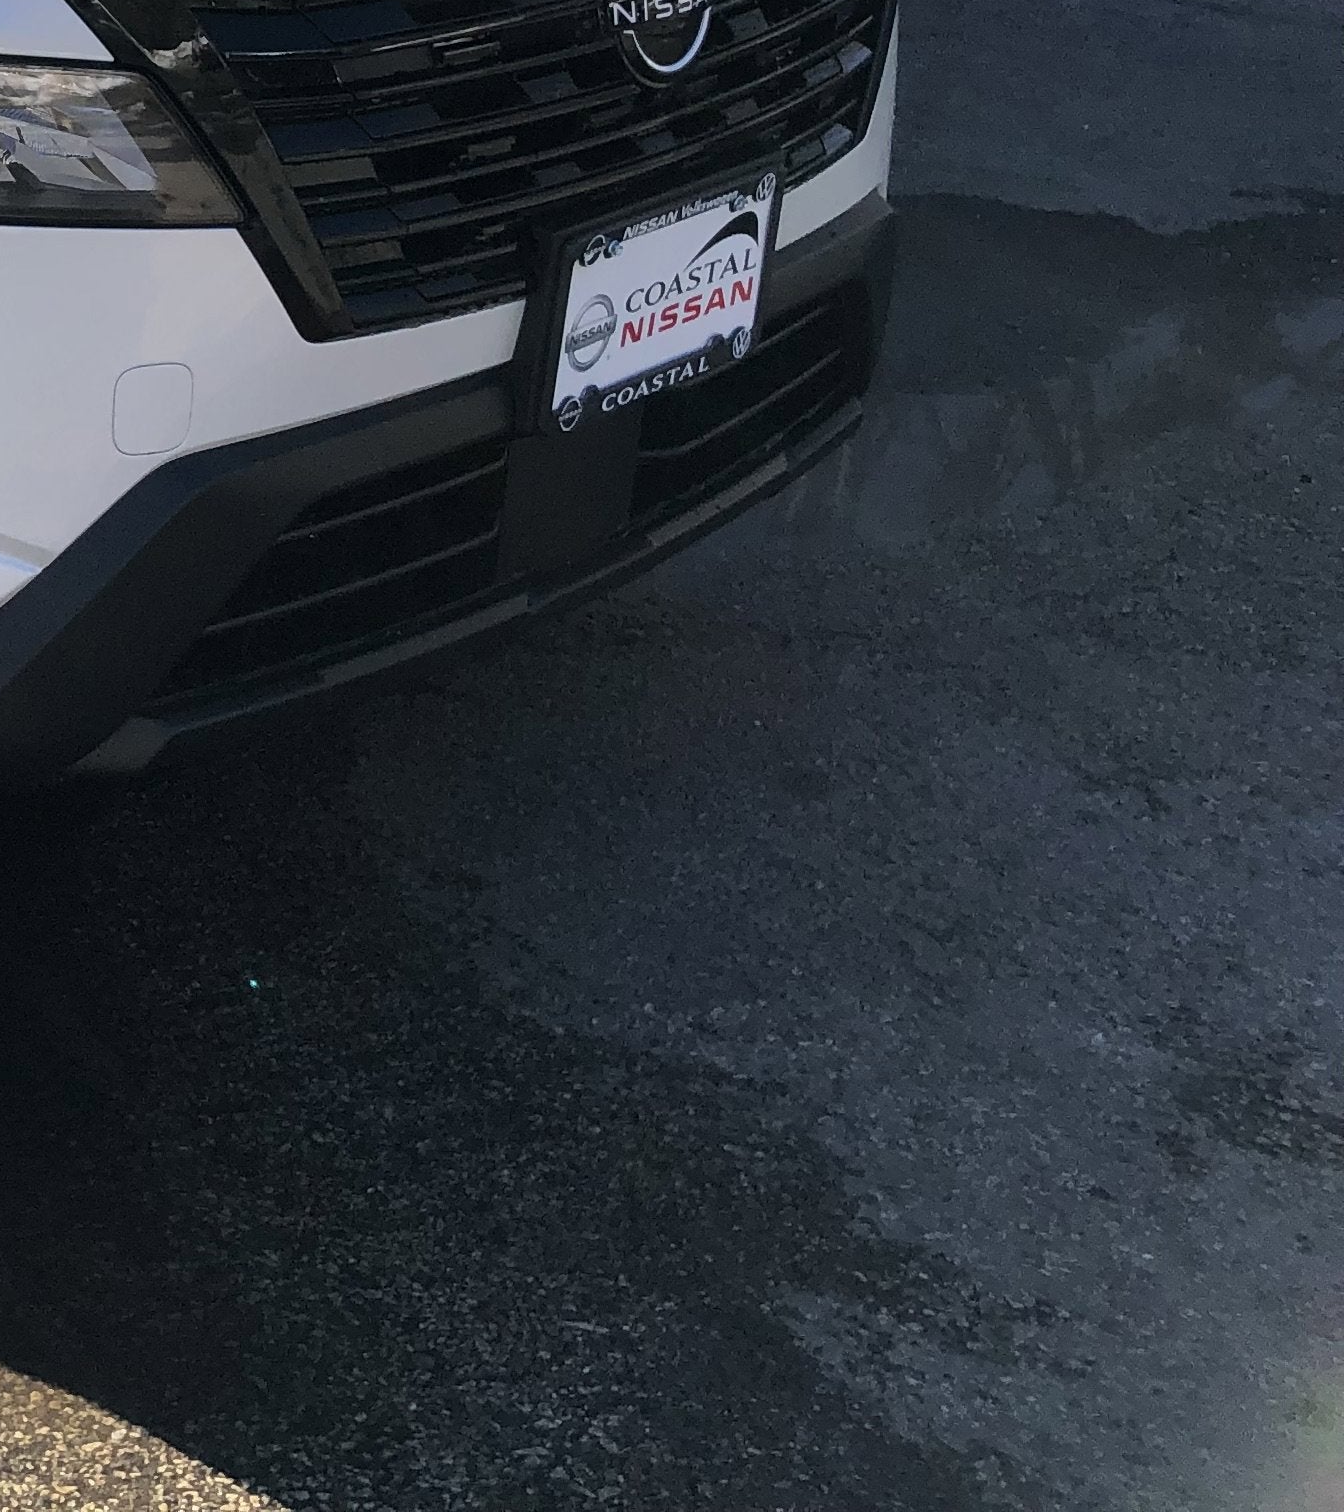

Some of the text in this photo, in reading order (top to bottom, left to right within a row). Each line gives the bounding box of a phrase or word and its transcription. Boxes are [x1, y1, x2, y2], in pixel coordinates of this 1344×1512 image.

[622, 210, 679, 241] NISSAN
[625, 248, 757, 314] COASTAL
[570, 320, 613, 346] NISSAN
[620, 276, 754, 347] NISSAN
[601, 356, 711, 412] COASTAL
